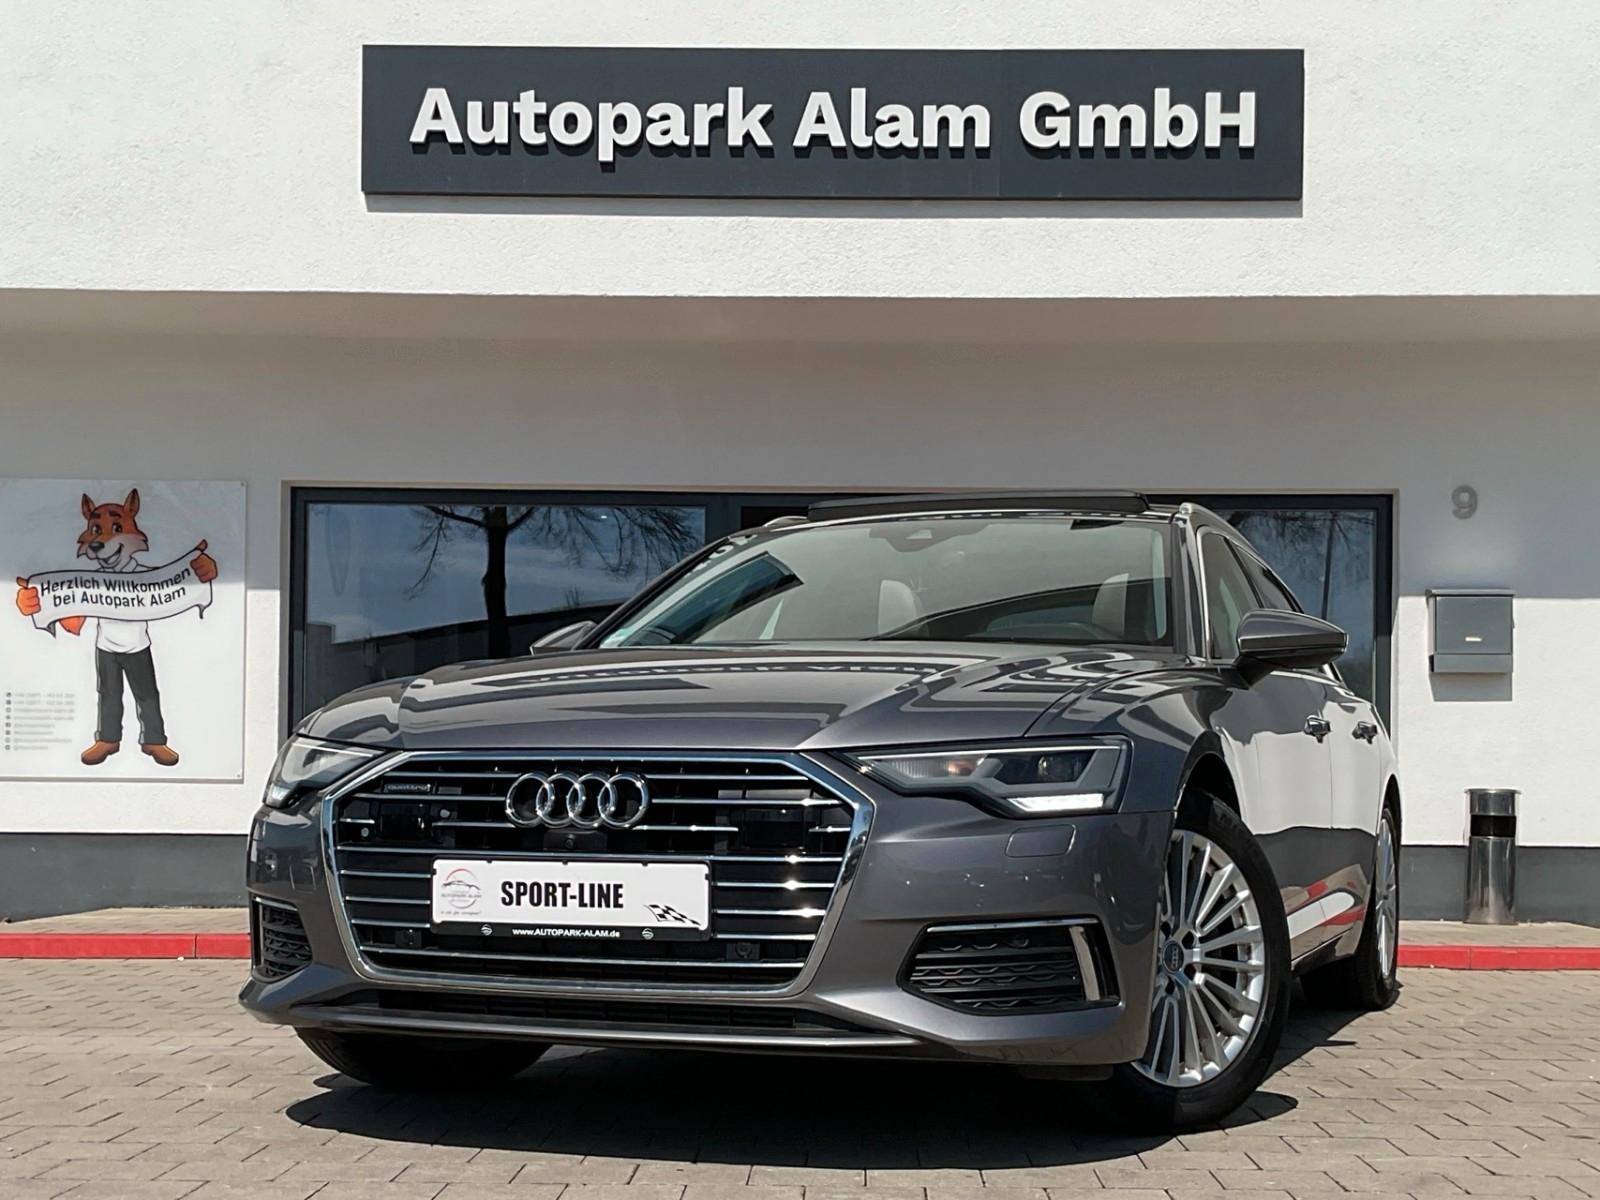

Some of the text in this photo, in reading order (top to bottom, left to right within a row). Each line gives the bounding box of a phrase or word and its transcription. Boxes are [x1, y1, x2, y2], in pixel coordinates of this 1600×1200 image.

[409, 87, 1257, 163] Autopark Alam GmbH
[1451, 485, 1479, 519] 9
[41, 567, 191, 597] Herzlich Willkommen
[53, 586, 186, 608] bei Autopark Alam
[501, 881, 623, 908] SPORT-LINE
[512, 928, 620, 938] www.AUTOPARK-ALAM.de
